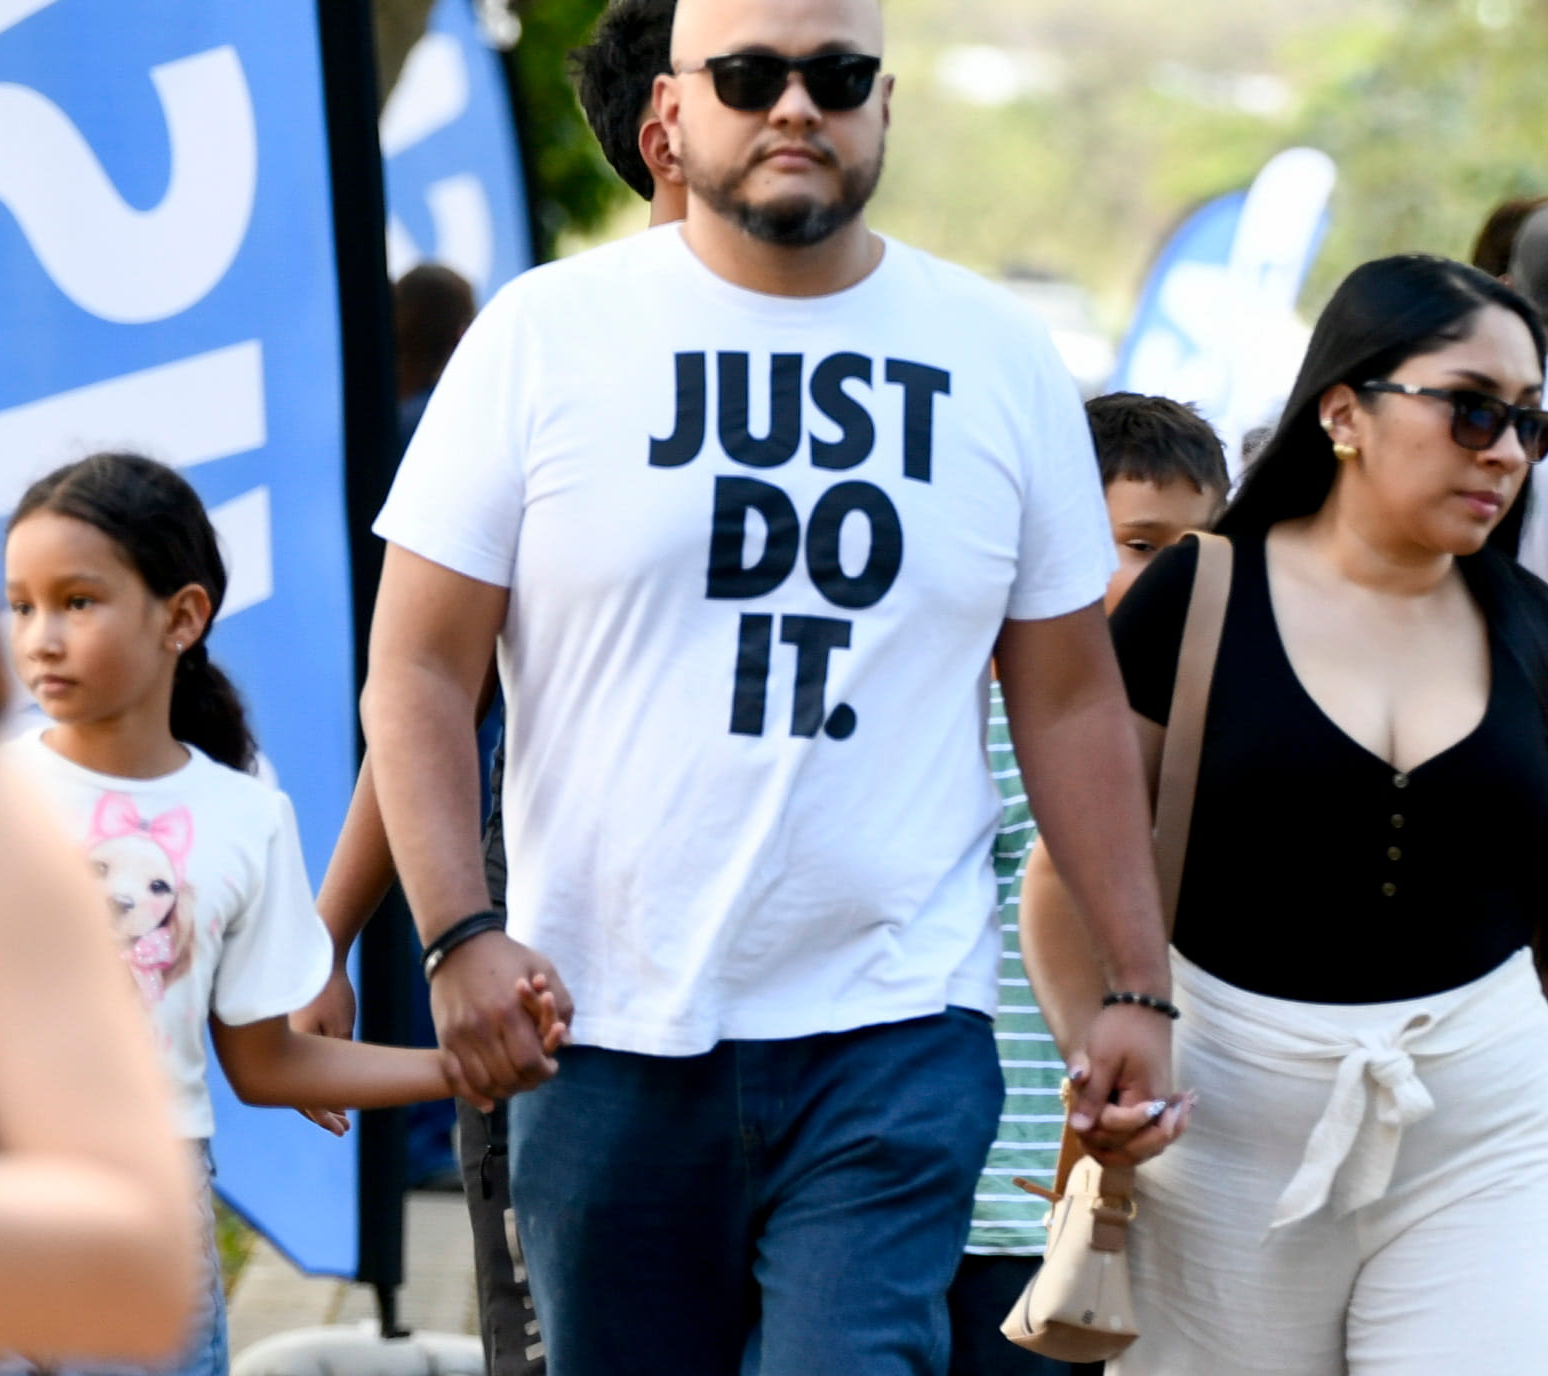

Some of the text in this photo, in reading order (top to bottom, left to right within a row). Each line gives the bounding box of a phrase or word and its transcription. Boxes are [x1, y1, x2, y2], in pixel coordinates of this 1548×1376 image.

[647, 350, 952, 485] JUST
[704, 474, 905, 611] DO
[728, 611, 859, 742] IT.
